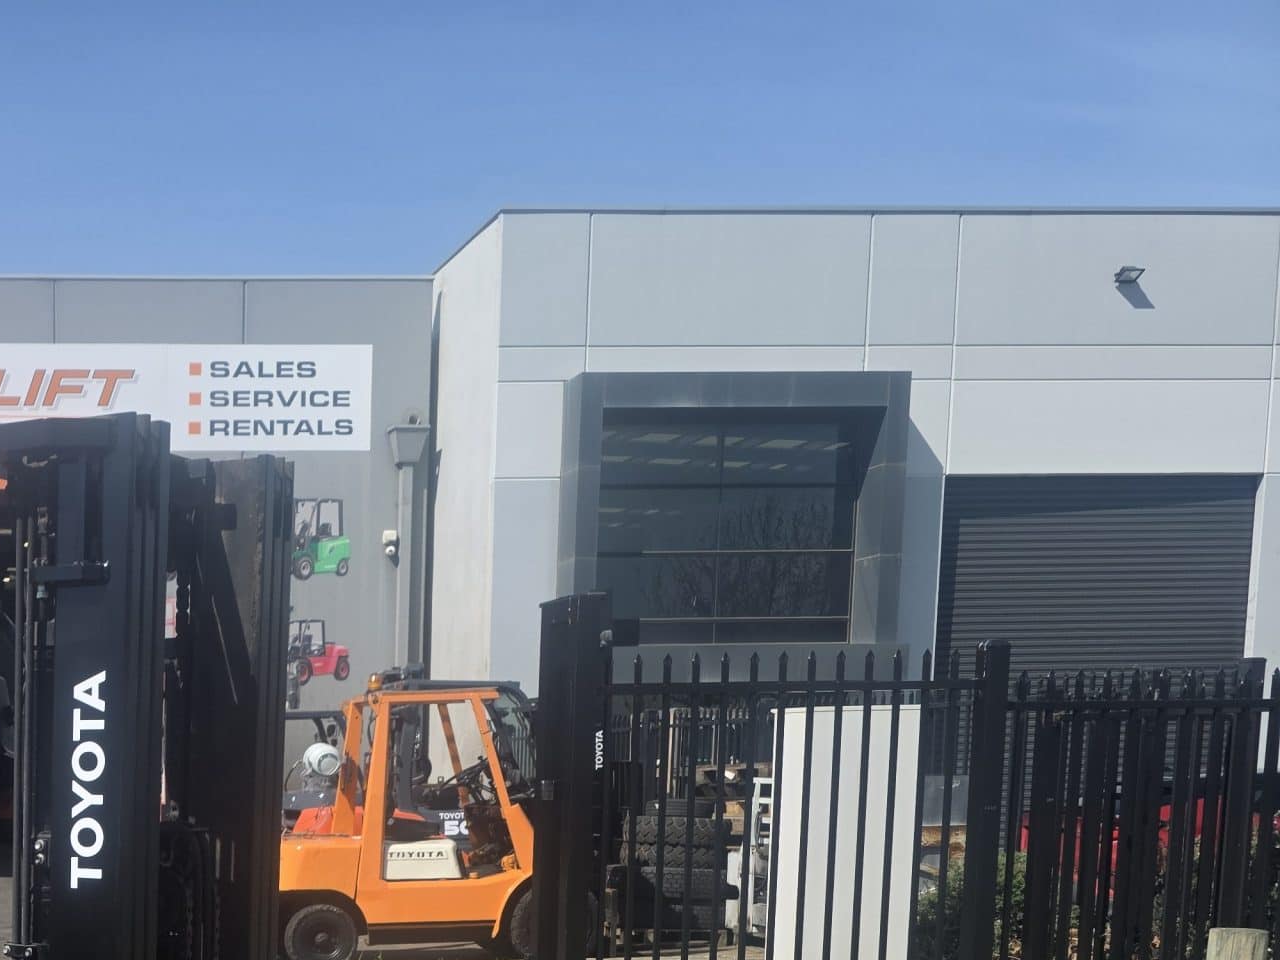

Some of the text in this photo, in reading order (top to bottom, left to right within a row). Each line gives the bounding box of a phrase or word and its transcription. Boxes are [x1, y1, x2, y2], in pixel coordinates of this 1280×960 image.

[210, 361, 316, 378] SALES
[210, 390, 351, 407] SERVICE
[209, 419, 354, 436] RENTALS
[595, 730, 604, 770] TOYOTA
[70, 670, 107, 889] TOYOTA
[439, 812, 464, 820] TOYOT
